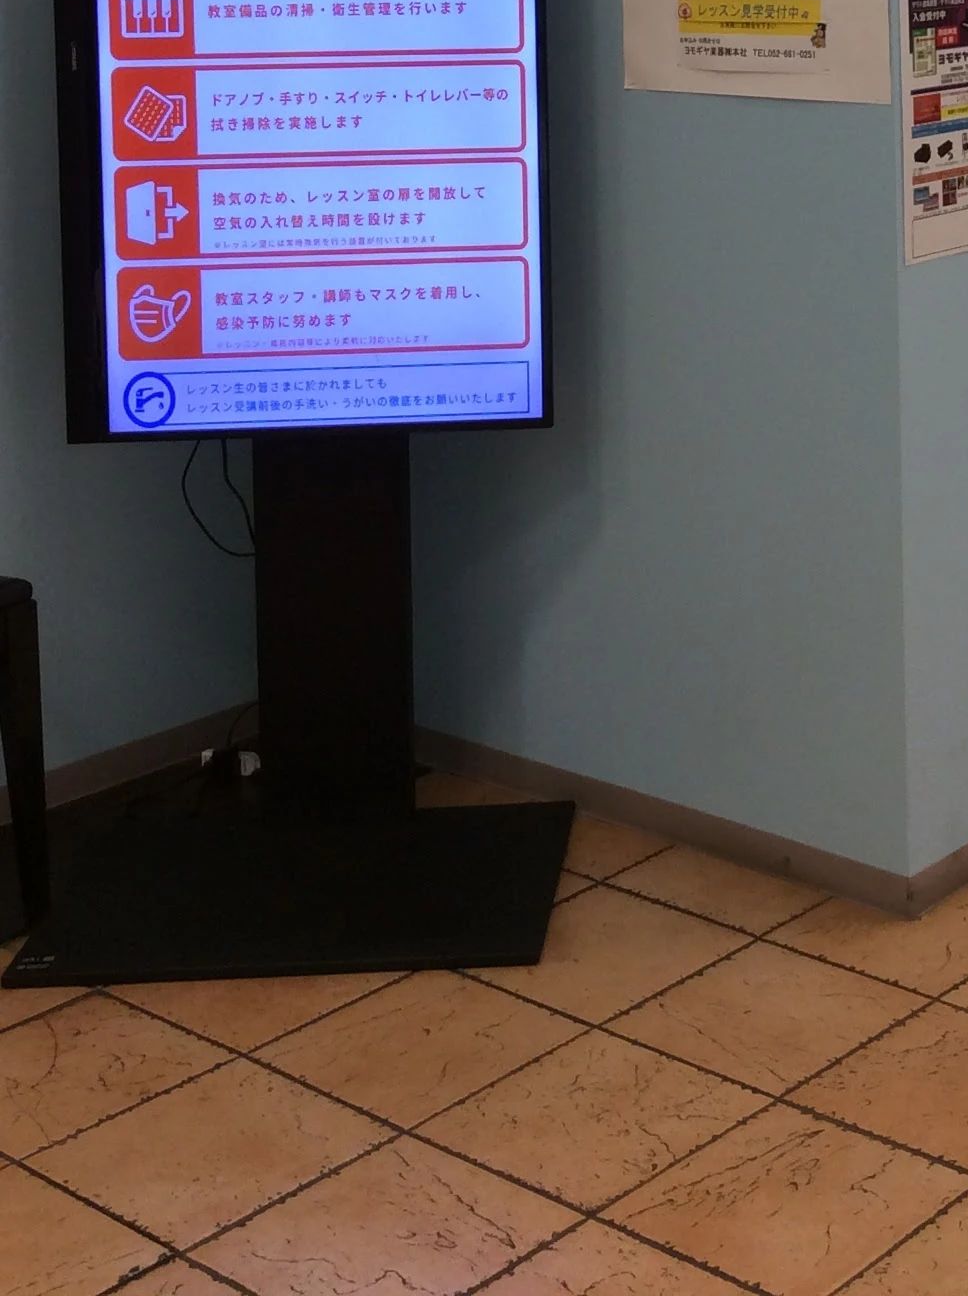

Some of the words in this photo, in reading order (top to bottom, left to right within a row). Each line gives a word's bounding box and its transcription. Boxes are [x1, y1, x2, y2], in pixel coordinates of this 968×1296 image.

[697, 2, 801, 20] レッスン見学受付中
[210, 113, 364, 133] 拭き掃除を実施します
[213, 211, 427, 231] 空気の入れ替え時間を設けます
[215, 313, 352, 331] 感染予防に努めます
